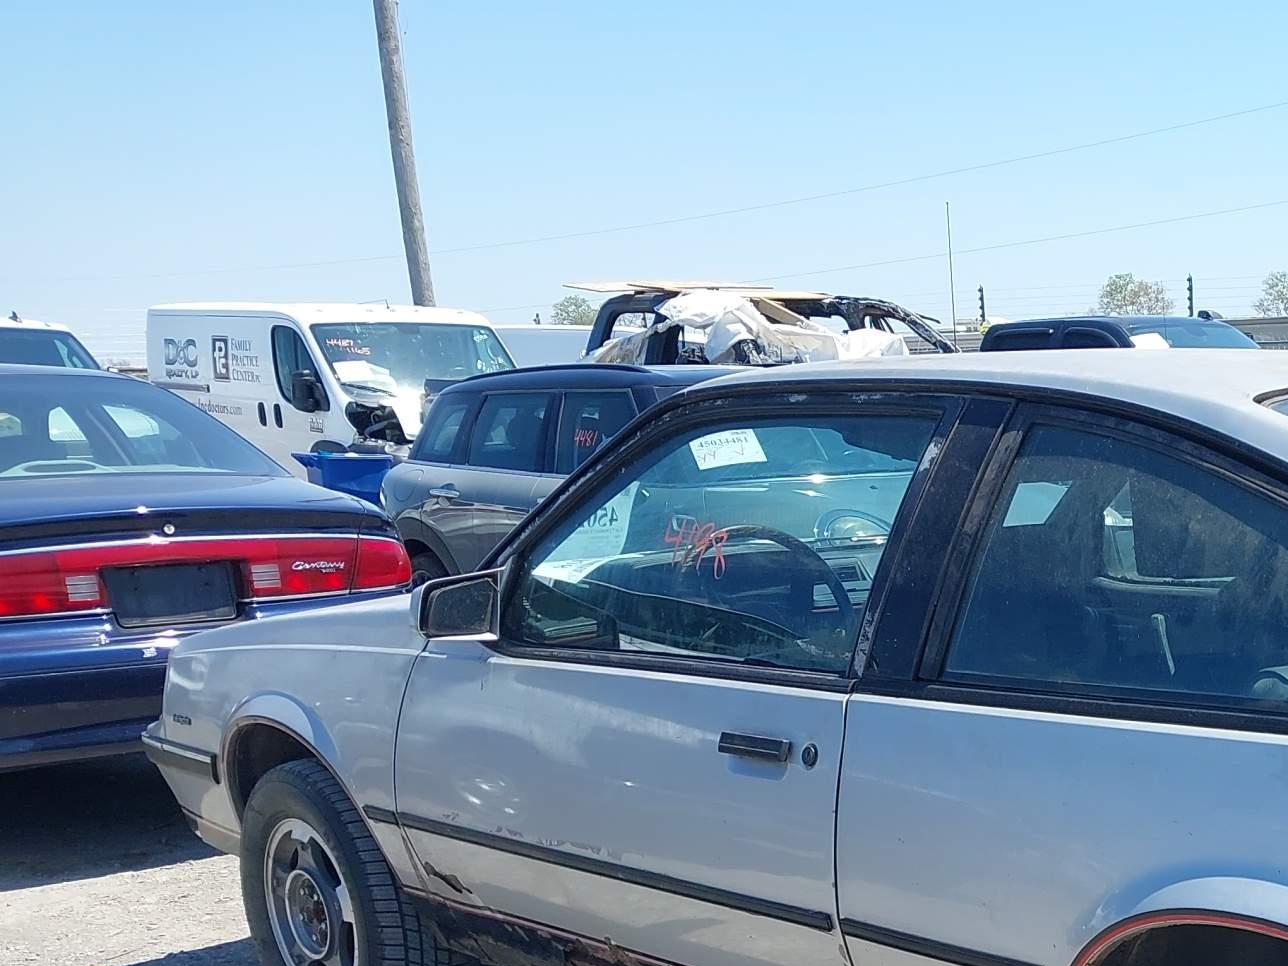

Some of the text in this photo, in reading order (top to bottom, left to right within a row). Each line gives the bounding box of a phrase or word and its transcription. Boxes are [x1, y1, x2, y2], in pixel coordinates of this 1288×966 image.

[231, 338, 252, 351] FAMILY
[231, 352, 260, 367] PRACTICE
[574, 428, 599, 447] 4481
[291, 561, 345, 570] Century
